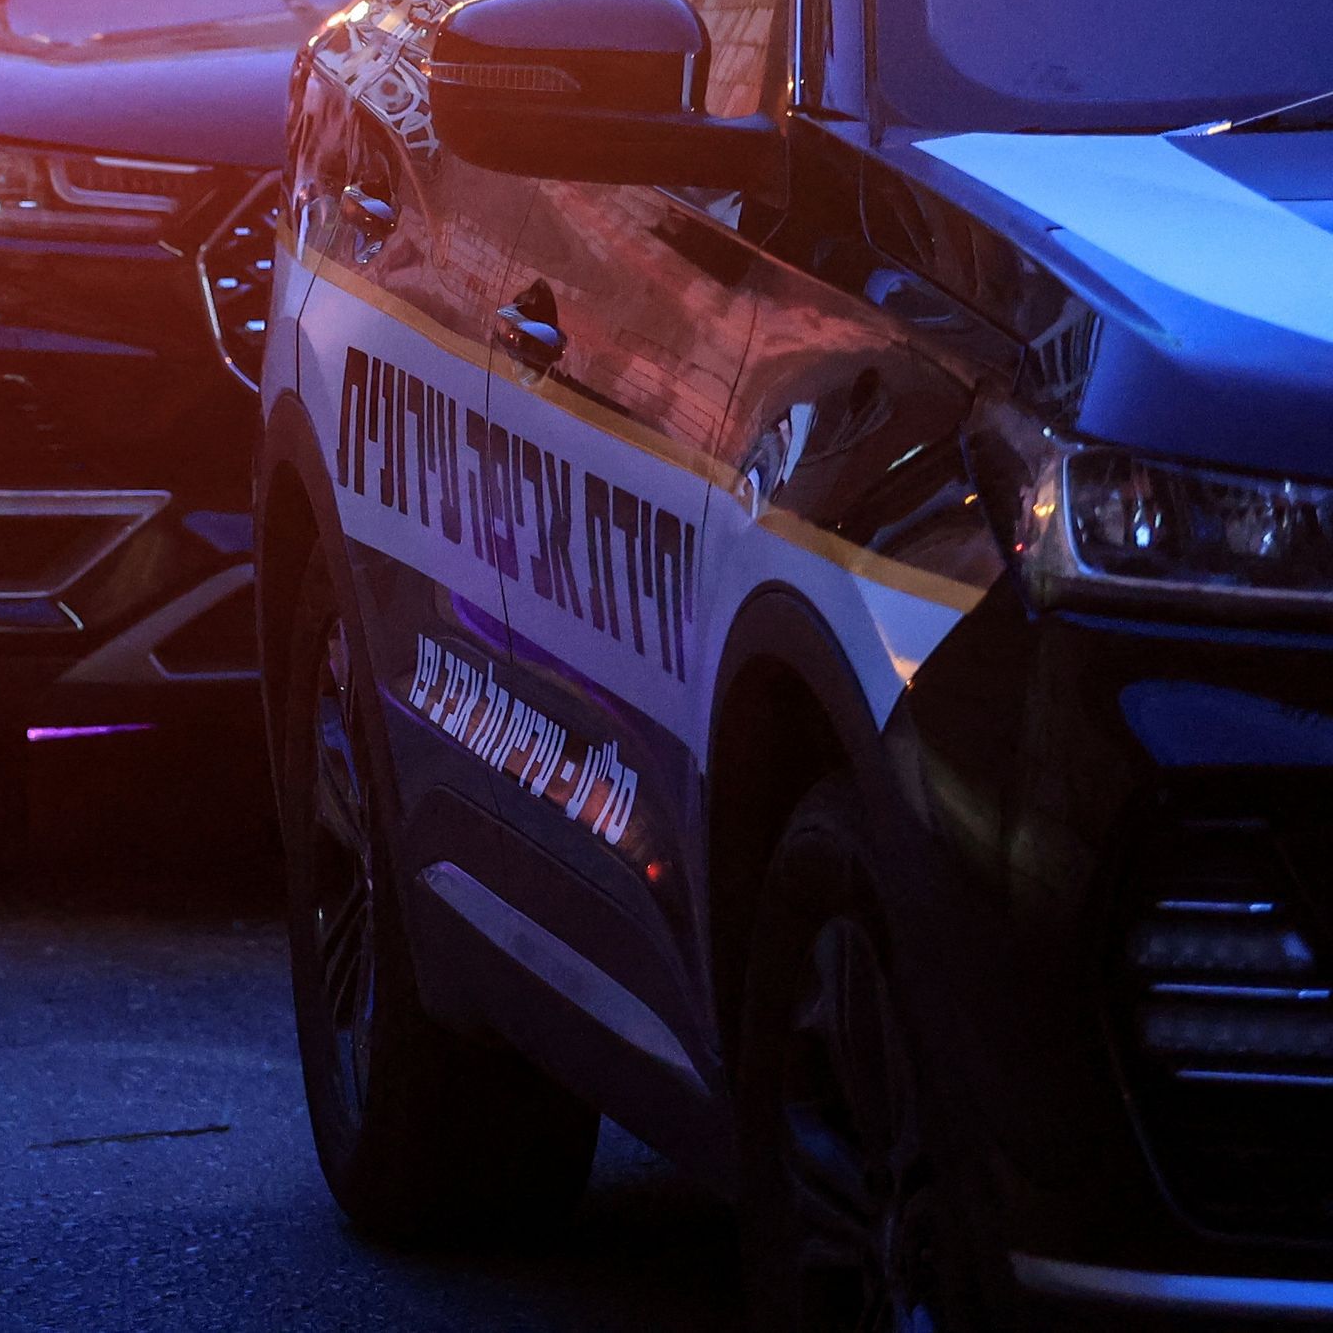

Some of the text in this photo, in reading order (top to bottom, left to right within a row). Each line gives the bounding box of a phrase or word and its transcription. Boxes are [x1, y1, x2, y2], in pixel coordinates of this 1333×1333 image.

[336, 346, 696, 684] יחידת אכיפה עירונית
[408, 633, 442, 710] יפו
[429, 651, 483, 743] אביב
[467, 661, 510, 761] תל
[489, 698, 567, 798] עיריית
